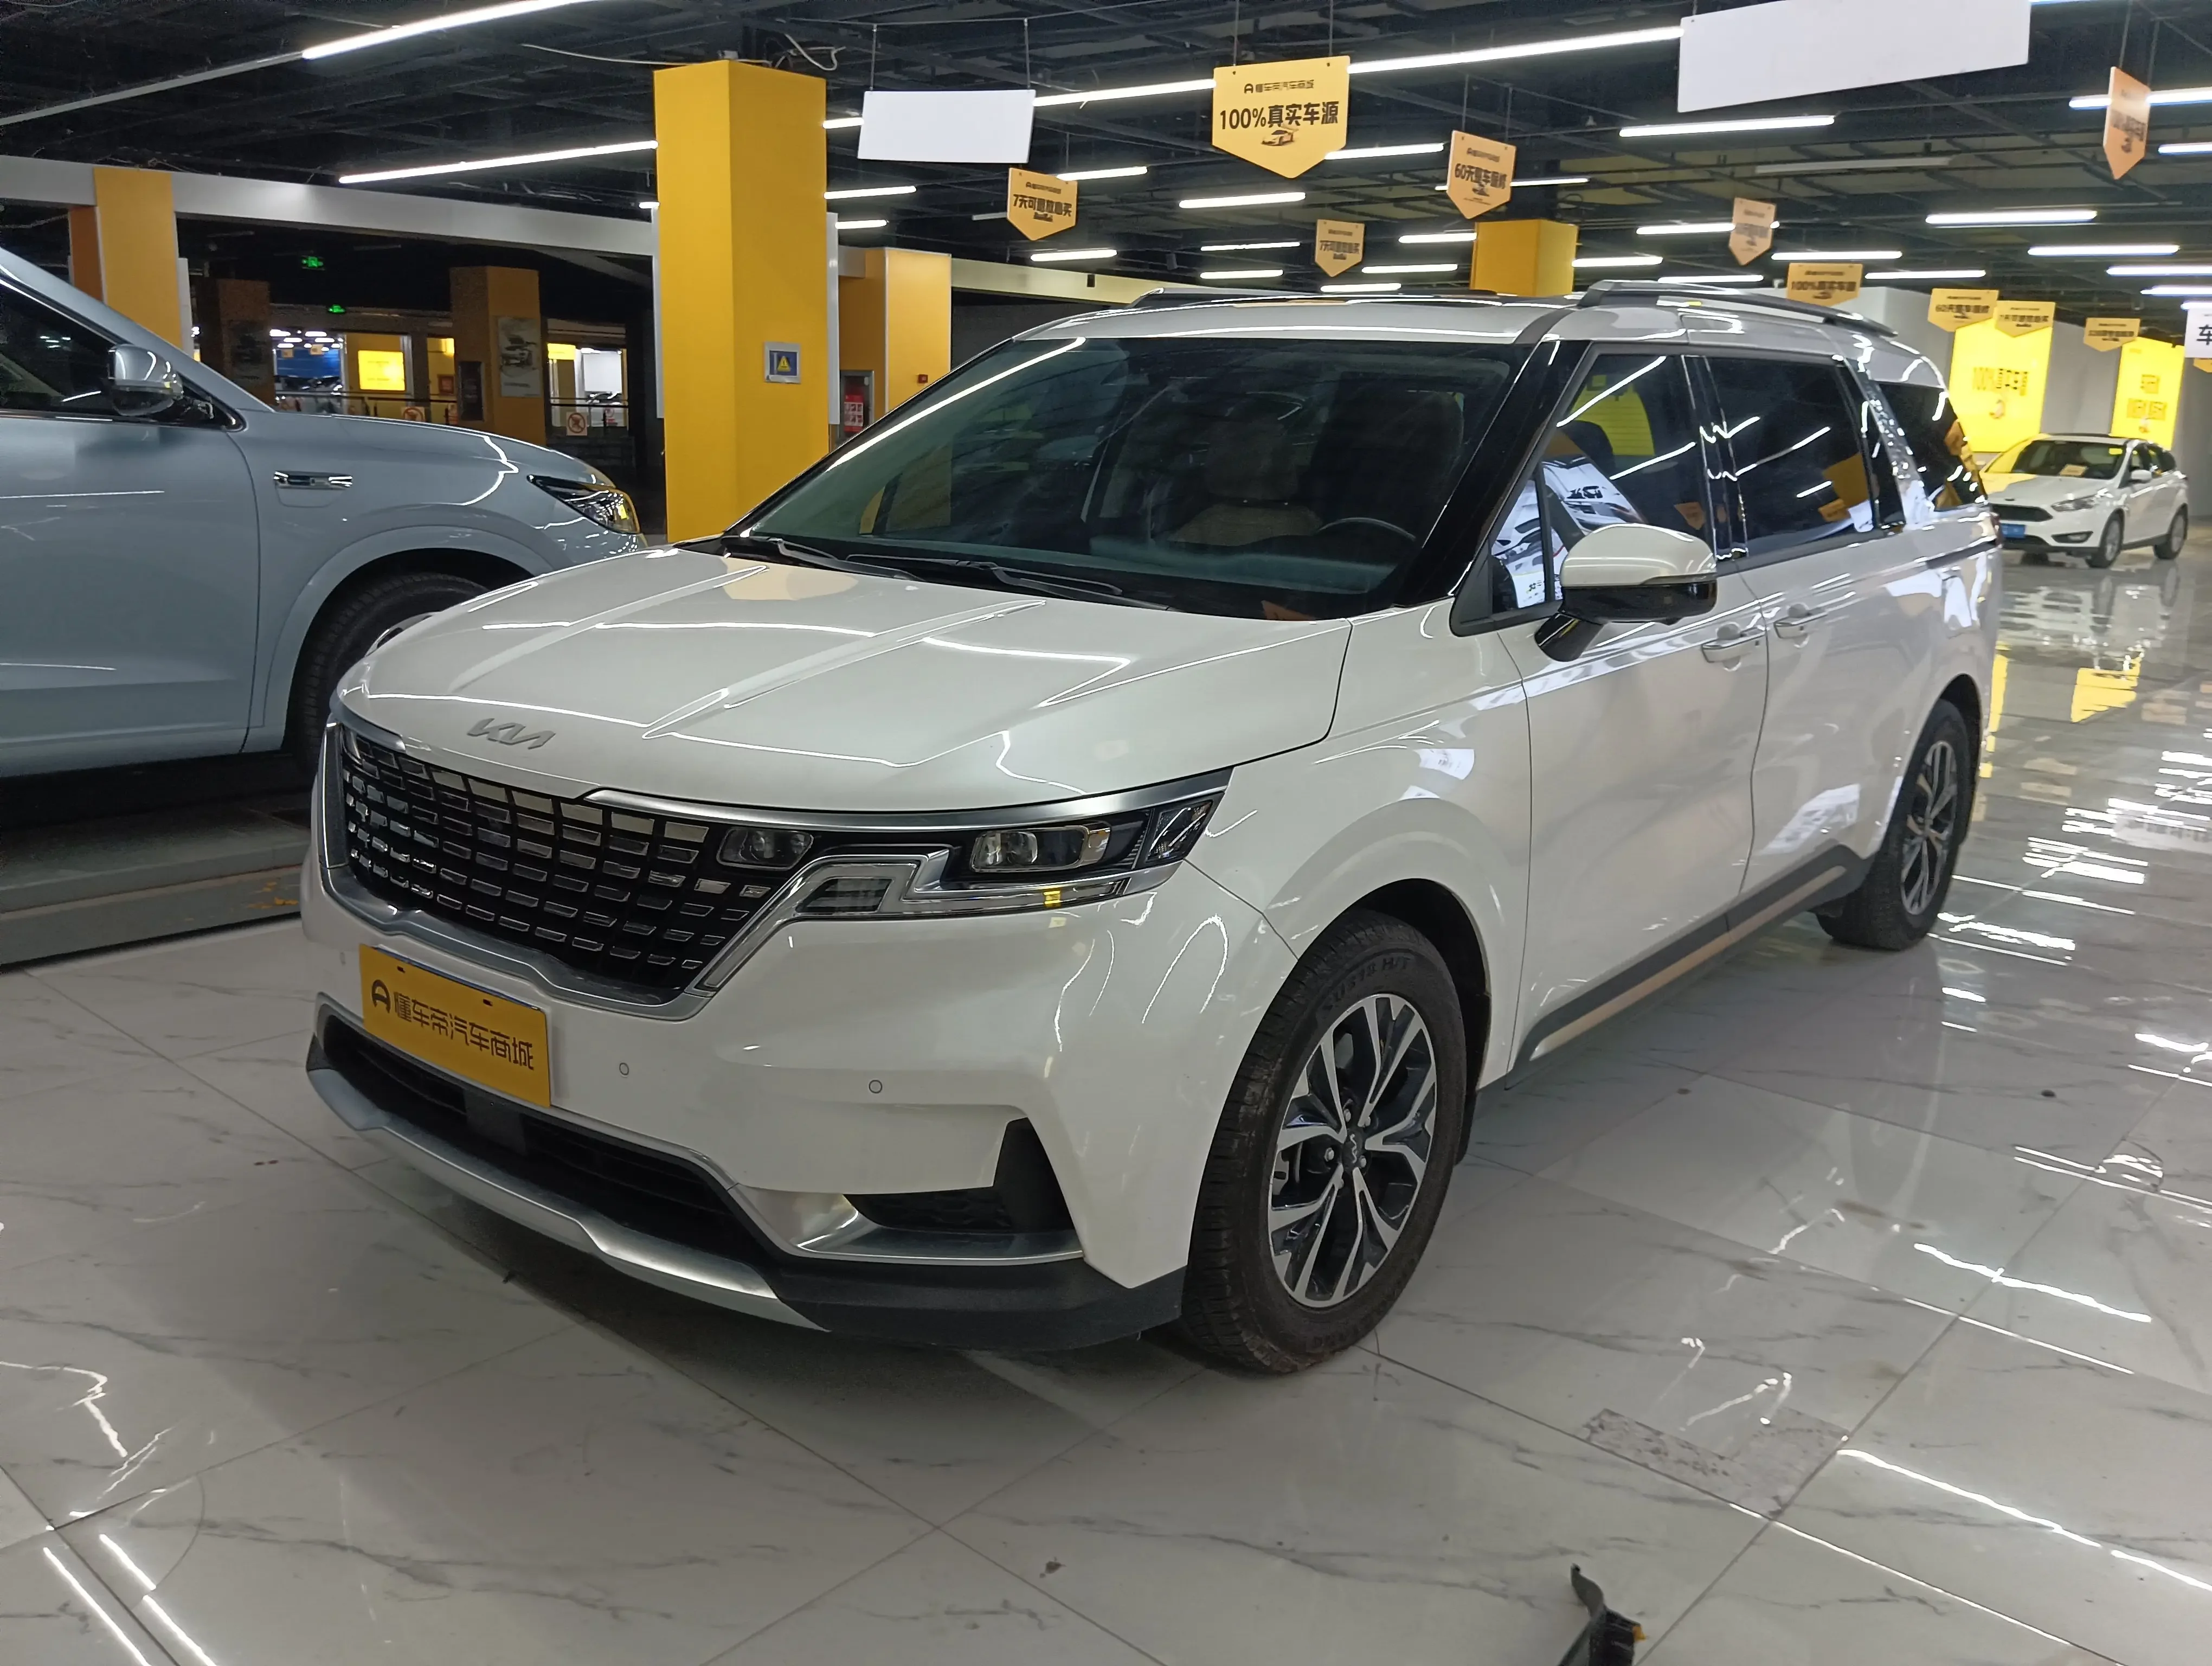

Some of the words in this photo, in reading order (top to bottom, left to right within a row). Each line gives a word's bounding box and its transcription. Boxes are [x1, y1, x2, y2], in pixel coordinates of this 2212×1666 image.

[1220, 101, 1339, 129] 100%真实车源
[1013, 194, 1073, 217] 7天可买
[466, 718, 556, 750] KIA
[393, 991, 535, 1071] 懂车帝汽车商城
